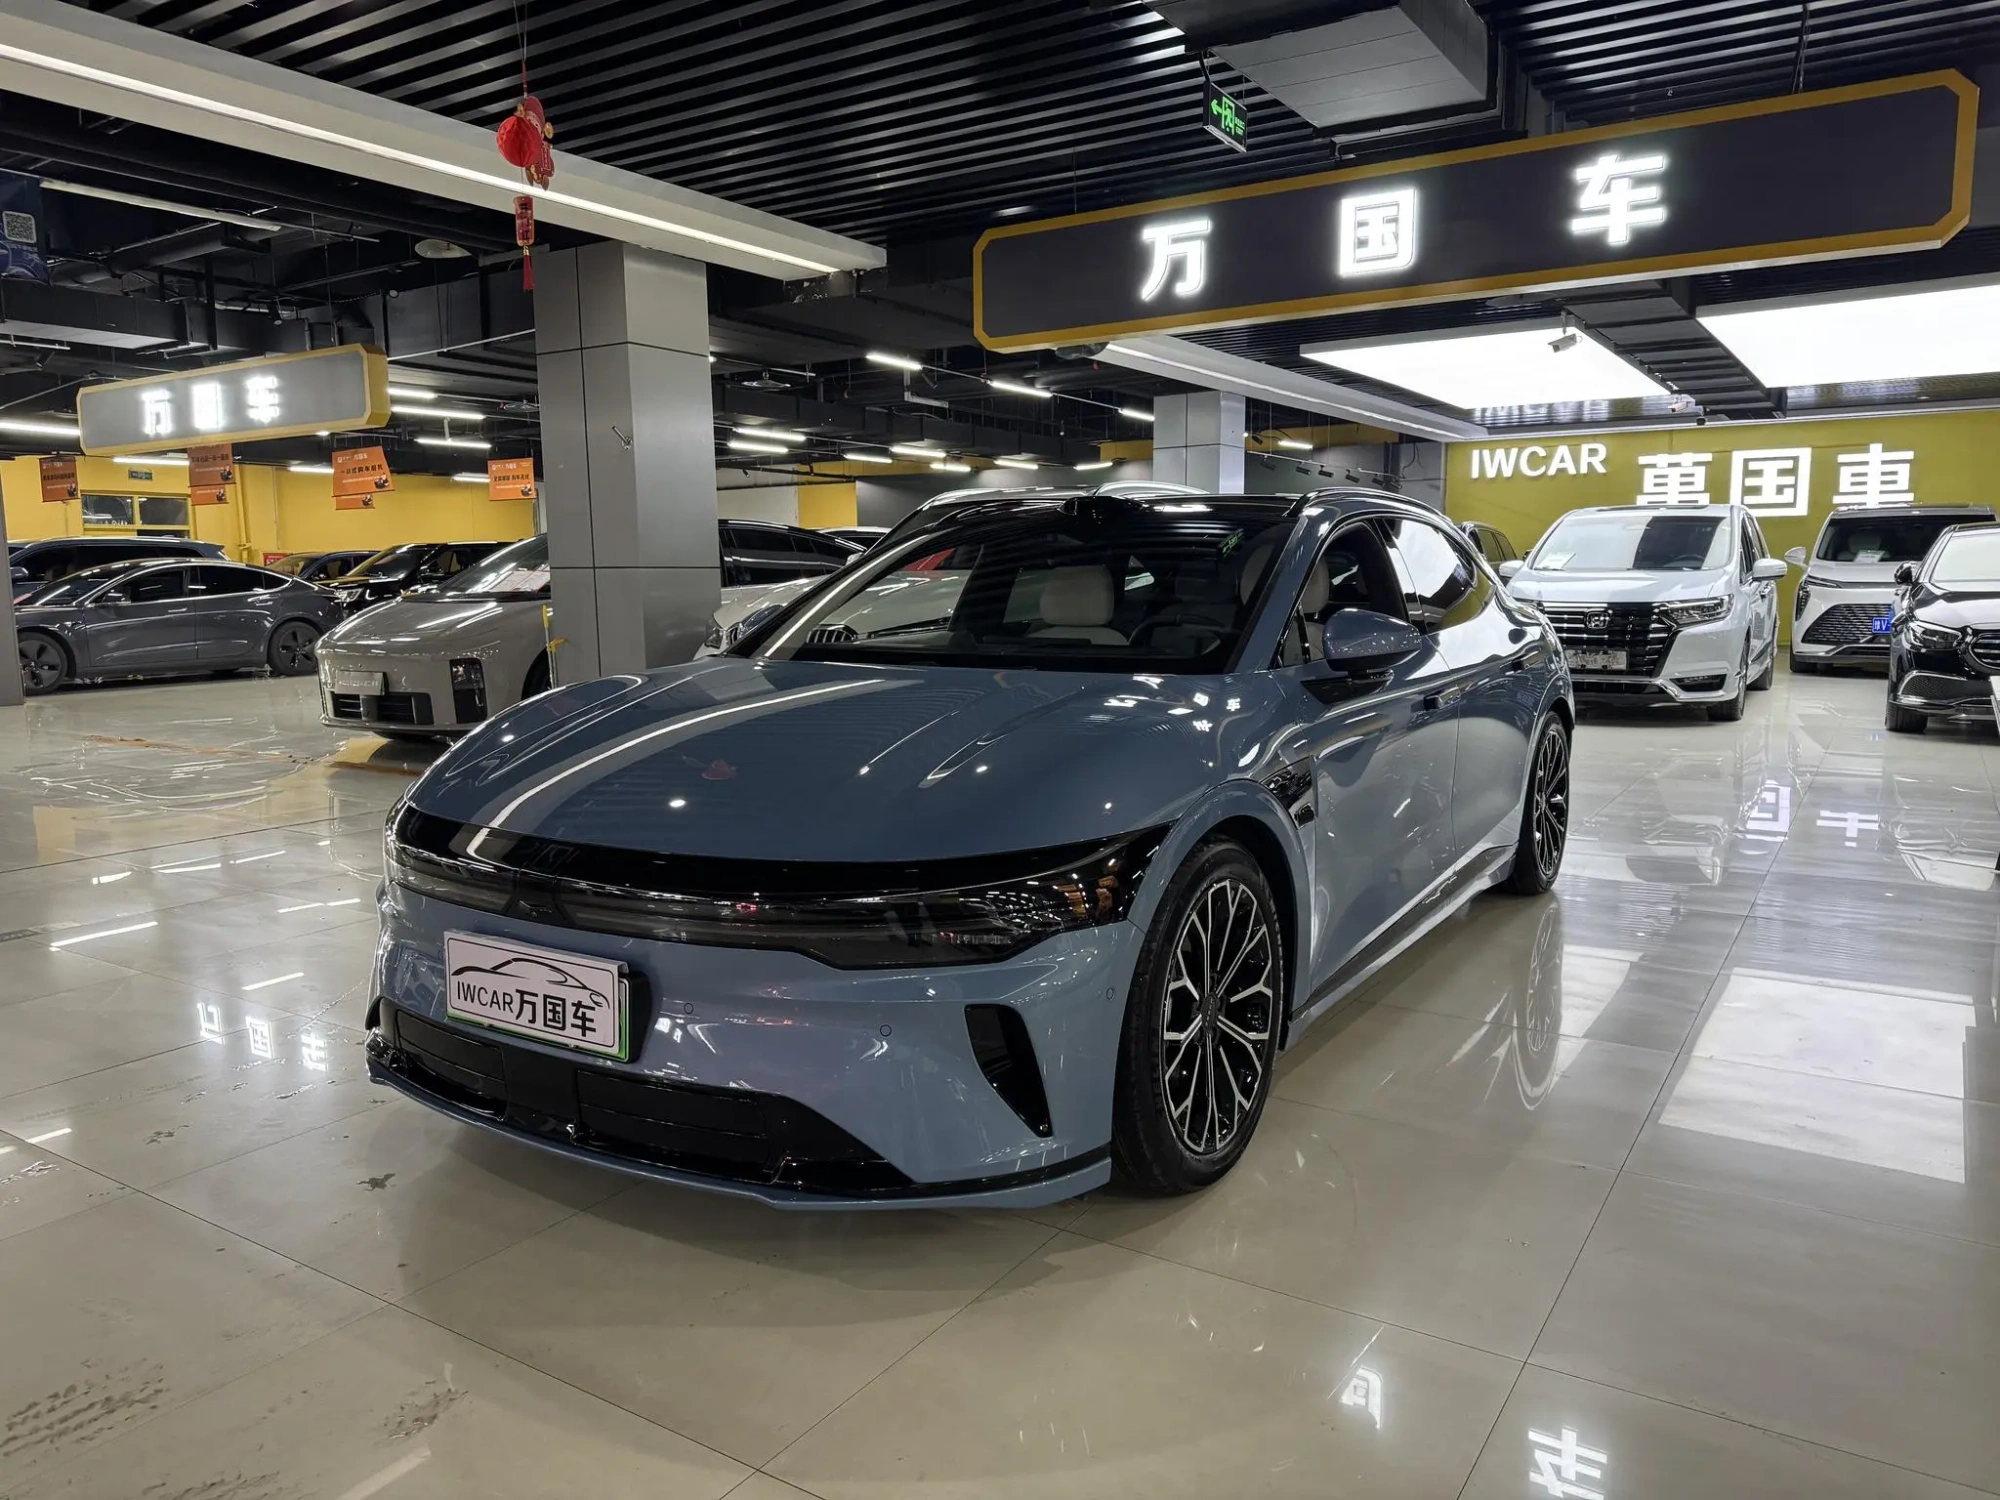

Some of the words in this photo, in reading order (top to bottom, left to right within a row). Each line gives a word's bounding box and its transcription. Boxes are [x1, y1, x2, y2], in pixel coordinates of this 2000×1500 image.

[1140, 150, 1670, 303] 万国车
[1471, 442, 1607, 479] IWCAR
